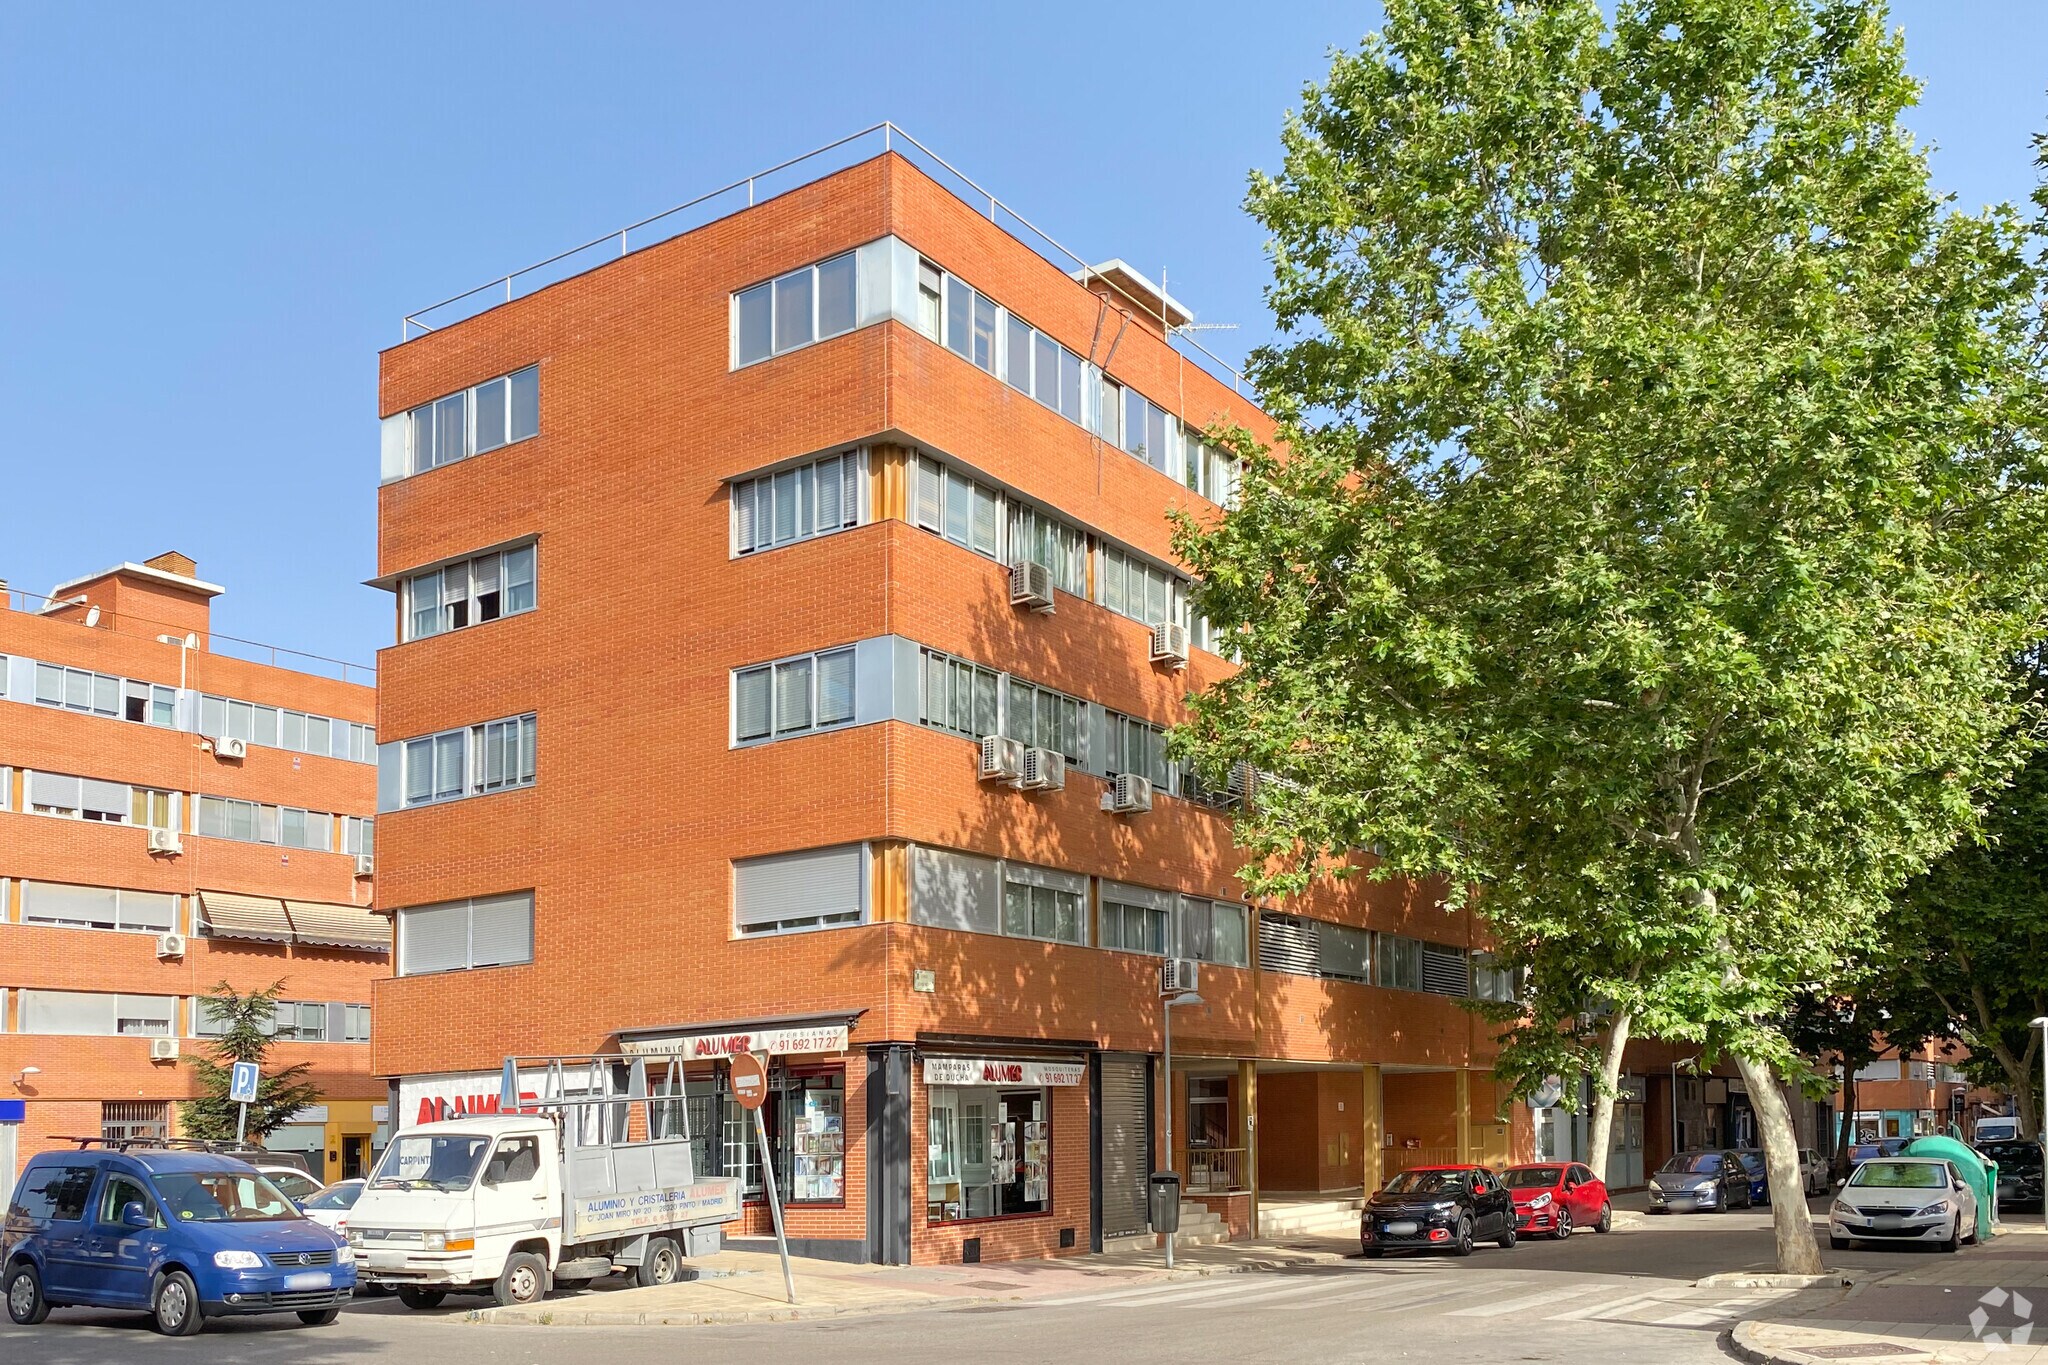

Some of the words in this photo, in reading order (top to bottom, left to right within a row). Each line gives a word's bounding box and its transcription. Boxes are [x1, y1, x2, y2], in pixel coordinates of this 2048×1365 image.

[779, 1028, 838, 1039] PERSIANAS
[695, 1035, 751, 1055] ALUMER
[779, 1039, 790, 1051] 91
[792, 1038, 810, 1050] 692
[813, 1037, 824, 1049] 17
[826, 1036, 838, 1048] 27
[931, 1062, 970, 1072] MAMPARAS
[982, 1063, 1023, 1083] ALUMER
[1043, 1065, 1081, 1073] MOSQUITERAS
[236, 1066, 249, 1094] P
[934, 1072, 943, 1081] DE
[945, 1072, 970, 1082] DUCHA
[1045, 1073, 1053, 1084] 91
[1053, 1073, 1066, 1084] 692
[1066, 1073, 1073, 1084] 17
[1075, 1073, 1082, 1084] 27
[588, 1198, 626, 1213] ALUMINIO
[629, 1196, 636, 1207] Y
[638, 1190, 686, 1206] CRISTALERIA
[689, 1182, 727, 1199] ALUMER
[597, 1211, 614, 1222] JOAN
[615, 1210, 631, 1218] MIRO
[643, 1206, 652, 1215] 20
[679, 1201, 696, 1210] PINTO
